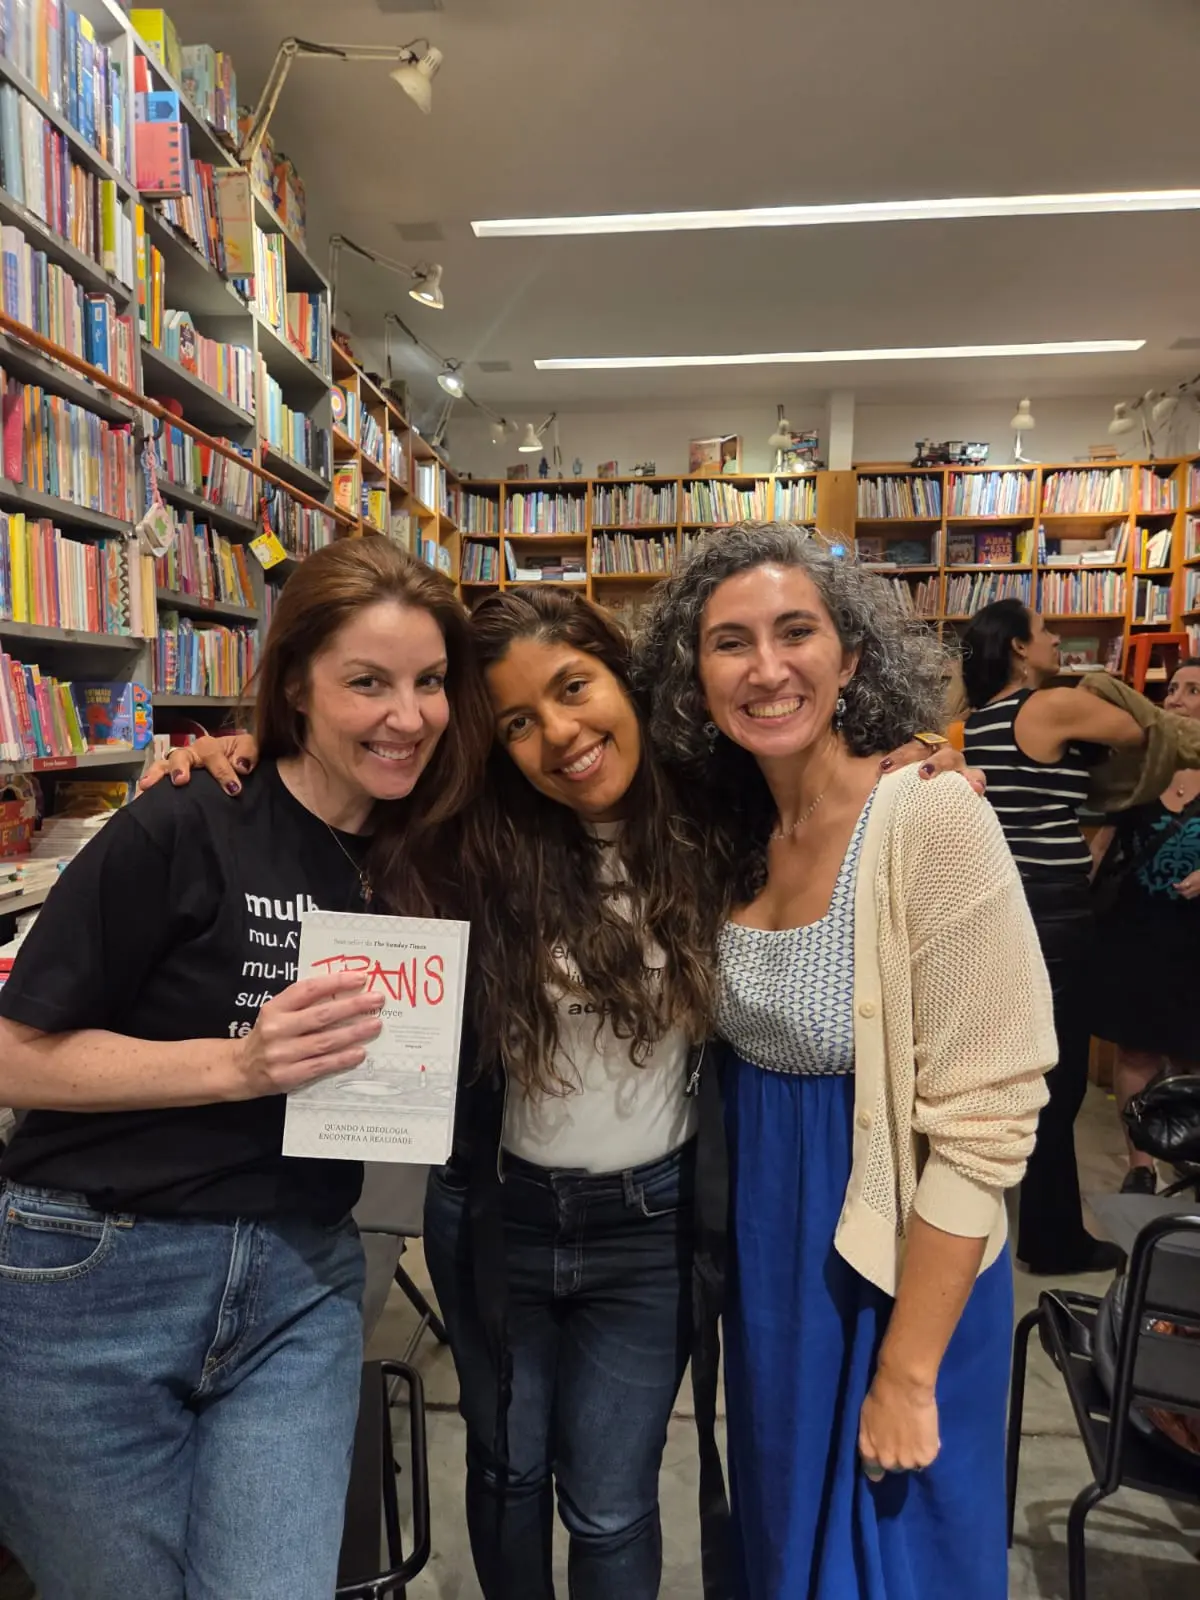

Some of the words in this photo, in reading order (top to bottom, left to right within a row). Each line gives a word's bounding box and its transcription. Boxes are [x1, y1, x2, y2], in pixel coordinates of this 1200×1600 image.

[386, 941, 408, 950] Sunday
[324, 1124, 358, 1132] QUANDO
[366, 1126, 408, 1134] IDEOLOGIA
[319, 1133, 361, 1141] ENCONTRA
[369, 1135, 412, 1144] REALIDADE
